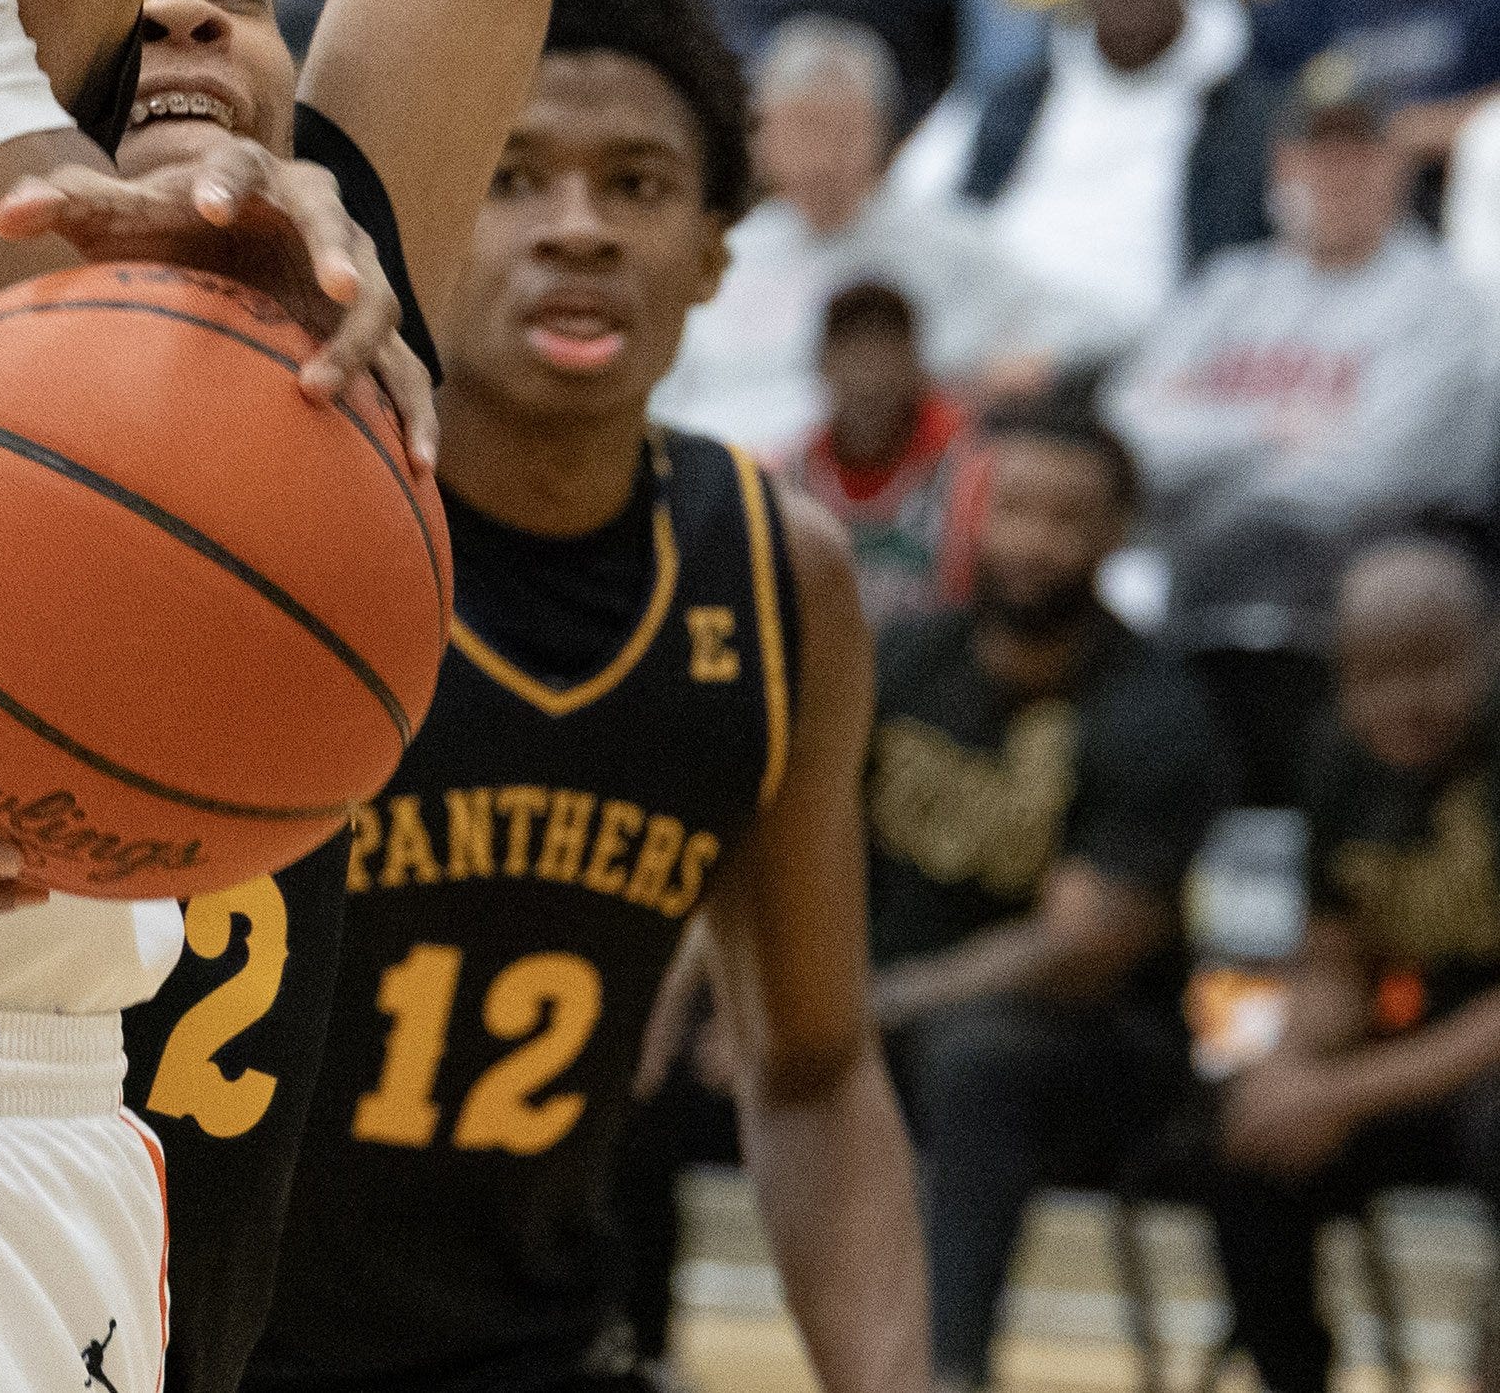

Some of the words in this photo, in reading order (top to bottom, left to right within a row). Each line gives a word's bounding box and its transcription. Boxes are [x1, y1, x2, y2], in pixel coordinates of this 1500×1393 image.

[686, 604, 741, 684] E
[345, 785, 721, 919] PANTHERS
[145, 871, 289, 1139] 2
[350, 942, 603, 1156] 12
